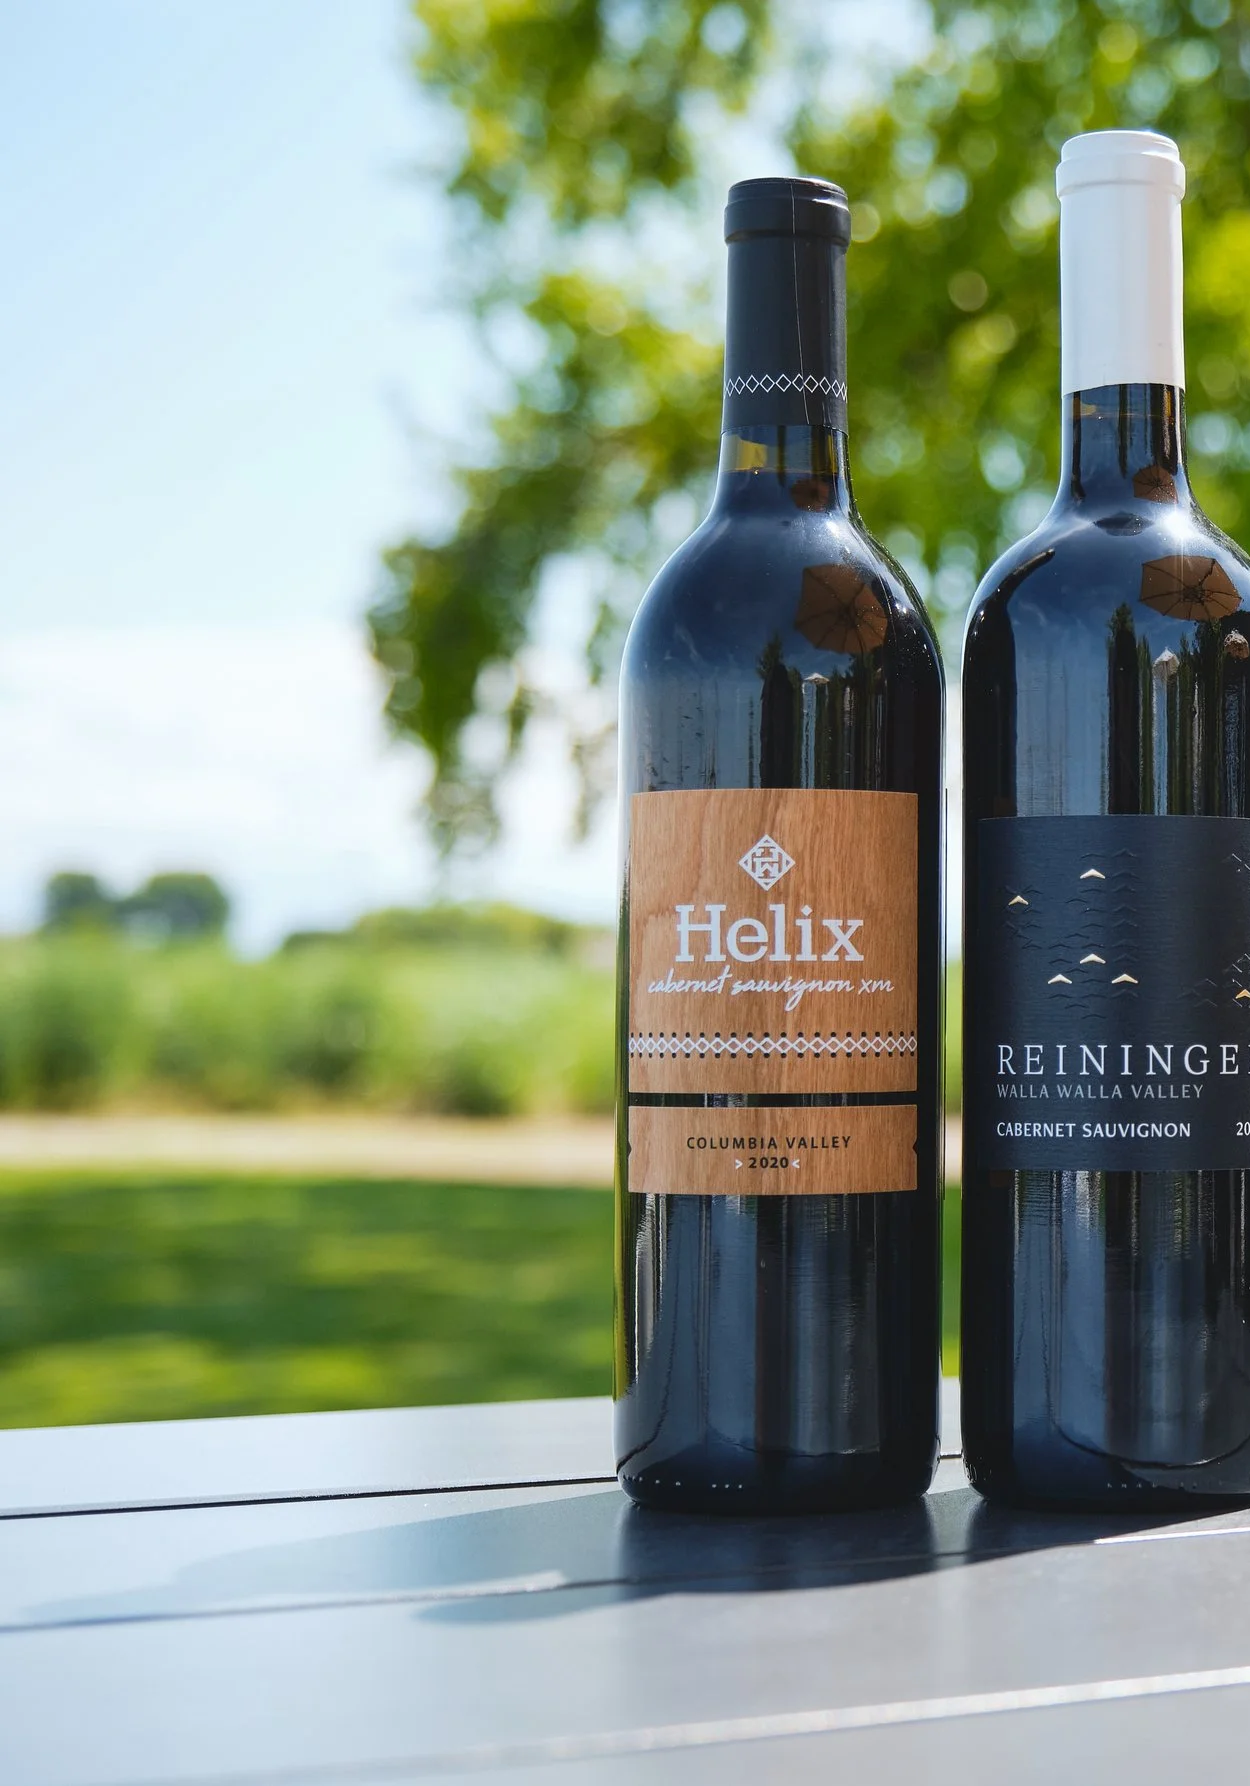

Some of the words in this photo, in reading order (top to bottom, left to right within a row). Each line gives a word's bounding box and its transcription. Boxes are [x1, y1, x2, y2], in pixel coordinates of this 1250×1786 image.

[676, 904, 864, 962] Helix
[648, 966, 733, 994] cabernet
[731, 975, 854, 1011] sauvignon
[997, 1084, 1049, 1099] WALLA
[1057, 1084, 1123, 1099] WALLA
[1131, 1084, 1204, 1099] VALLEY
[997, 1122, 1076, 1138] CABERNET
[1082, 1123, 1191, 1138] SAUVIGNON
[686, 1137, 778, 1150] COLUMBIA
[786, 1136, 852, 1149] VALLEY
[748, 1157, 789, 1169] 2020
